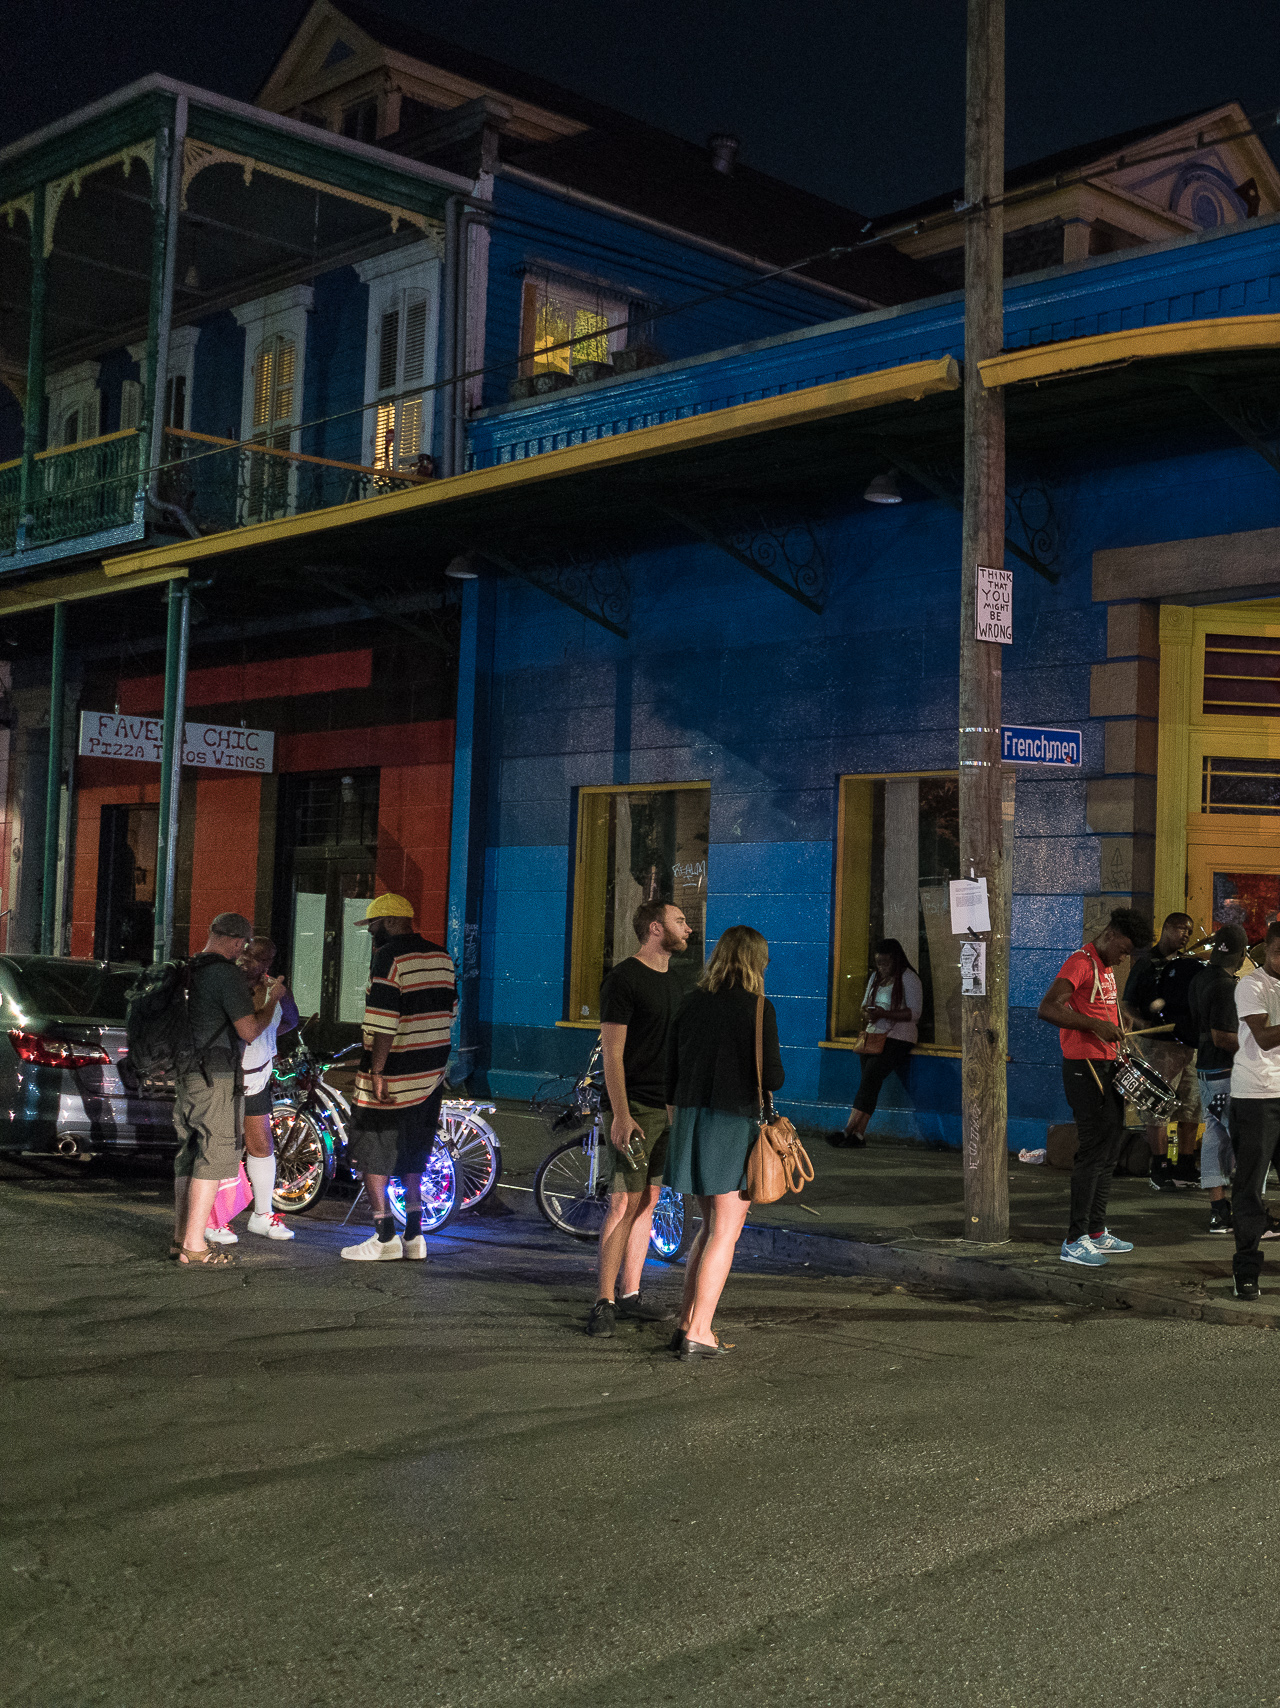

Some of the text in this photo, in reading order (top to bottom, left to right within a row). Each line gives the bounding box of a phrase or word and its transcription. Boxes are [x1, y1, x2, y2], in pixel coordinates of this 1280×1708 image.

[979, 568, 1012, 582] THINK
[988, 580, 1008, 591] THAT
[981, 588, 1010, 603] YOU
[983, 602, 1010, 612] MIGHT
[990, 611, 1001, 621] BE
[978, 622, 1012, 640] WRONG
[98, 715, 260, 751] FAVE CHIC
[88, 737, 145, 759] PIZZA
[153, 744, 207, 764] TOS
[1004, 731, 1077, 761] Frenchmen
